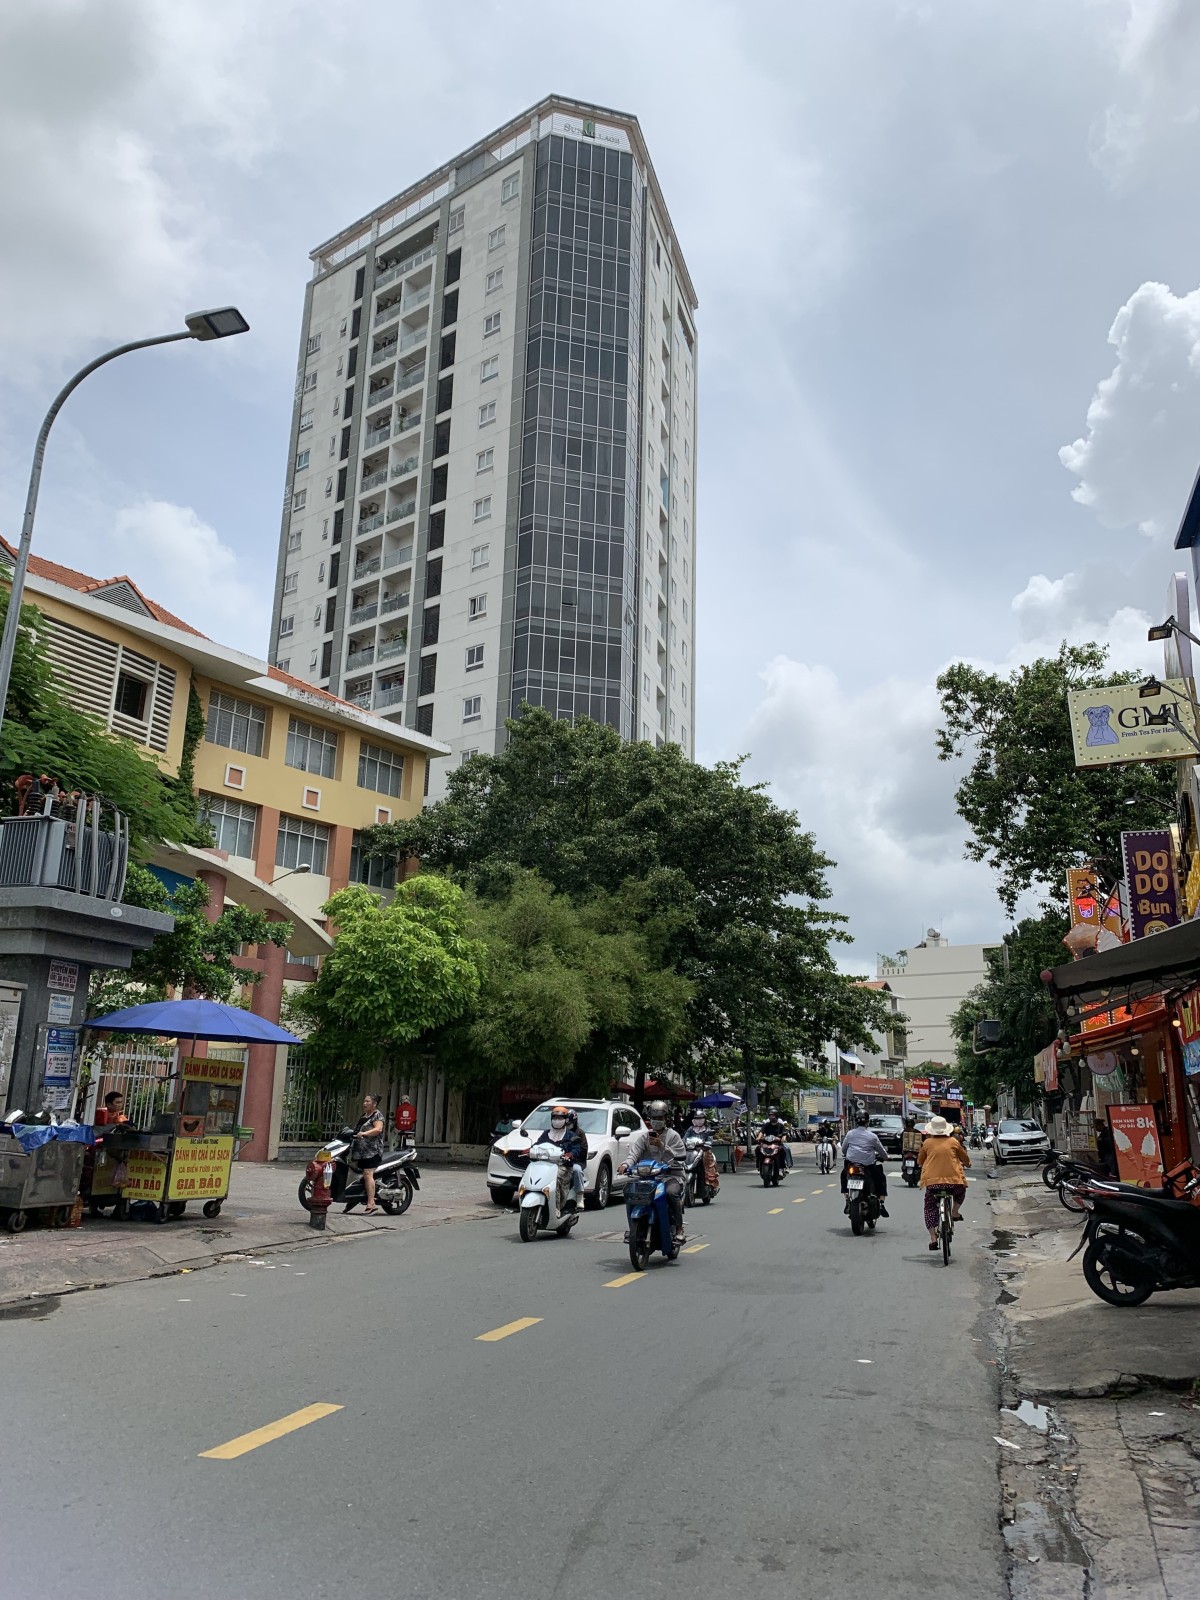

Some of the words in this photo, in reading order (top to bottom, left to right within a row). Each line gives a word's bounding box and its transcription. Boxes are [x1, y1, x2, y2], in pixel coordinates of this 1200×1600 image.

[1121, 729, 1138, 738] Fresh
[1139, 729, 1151, 737] Tea
[1135, 850, 1169, 872] DO
[1135, 873, 1169, 895] DO
[1139, 899, 1171, 915] Bun
[1136, 1116, 1154, 1129] 8k
[175, 1147, 190, 1161] BÁNH
[143, 1176, 161, 1191] BẢO
[176, 1178, 195, 1191] GIA
[198, 1174, 222, 1190] BẢO
